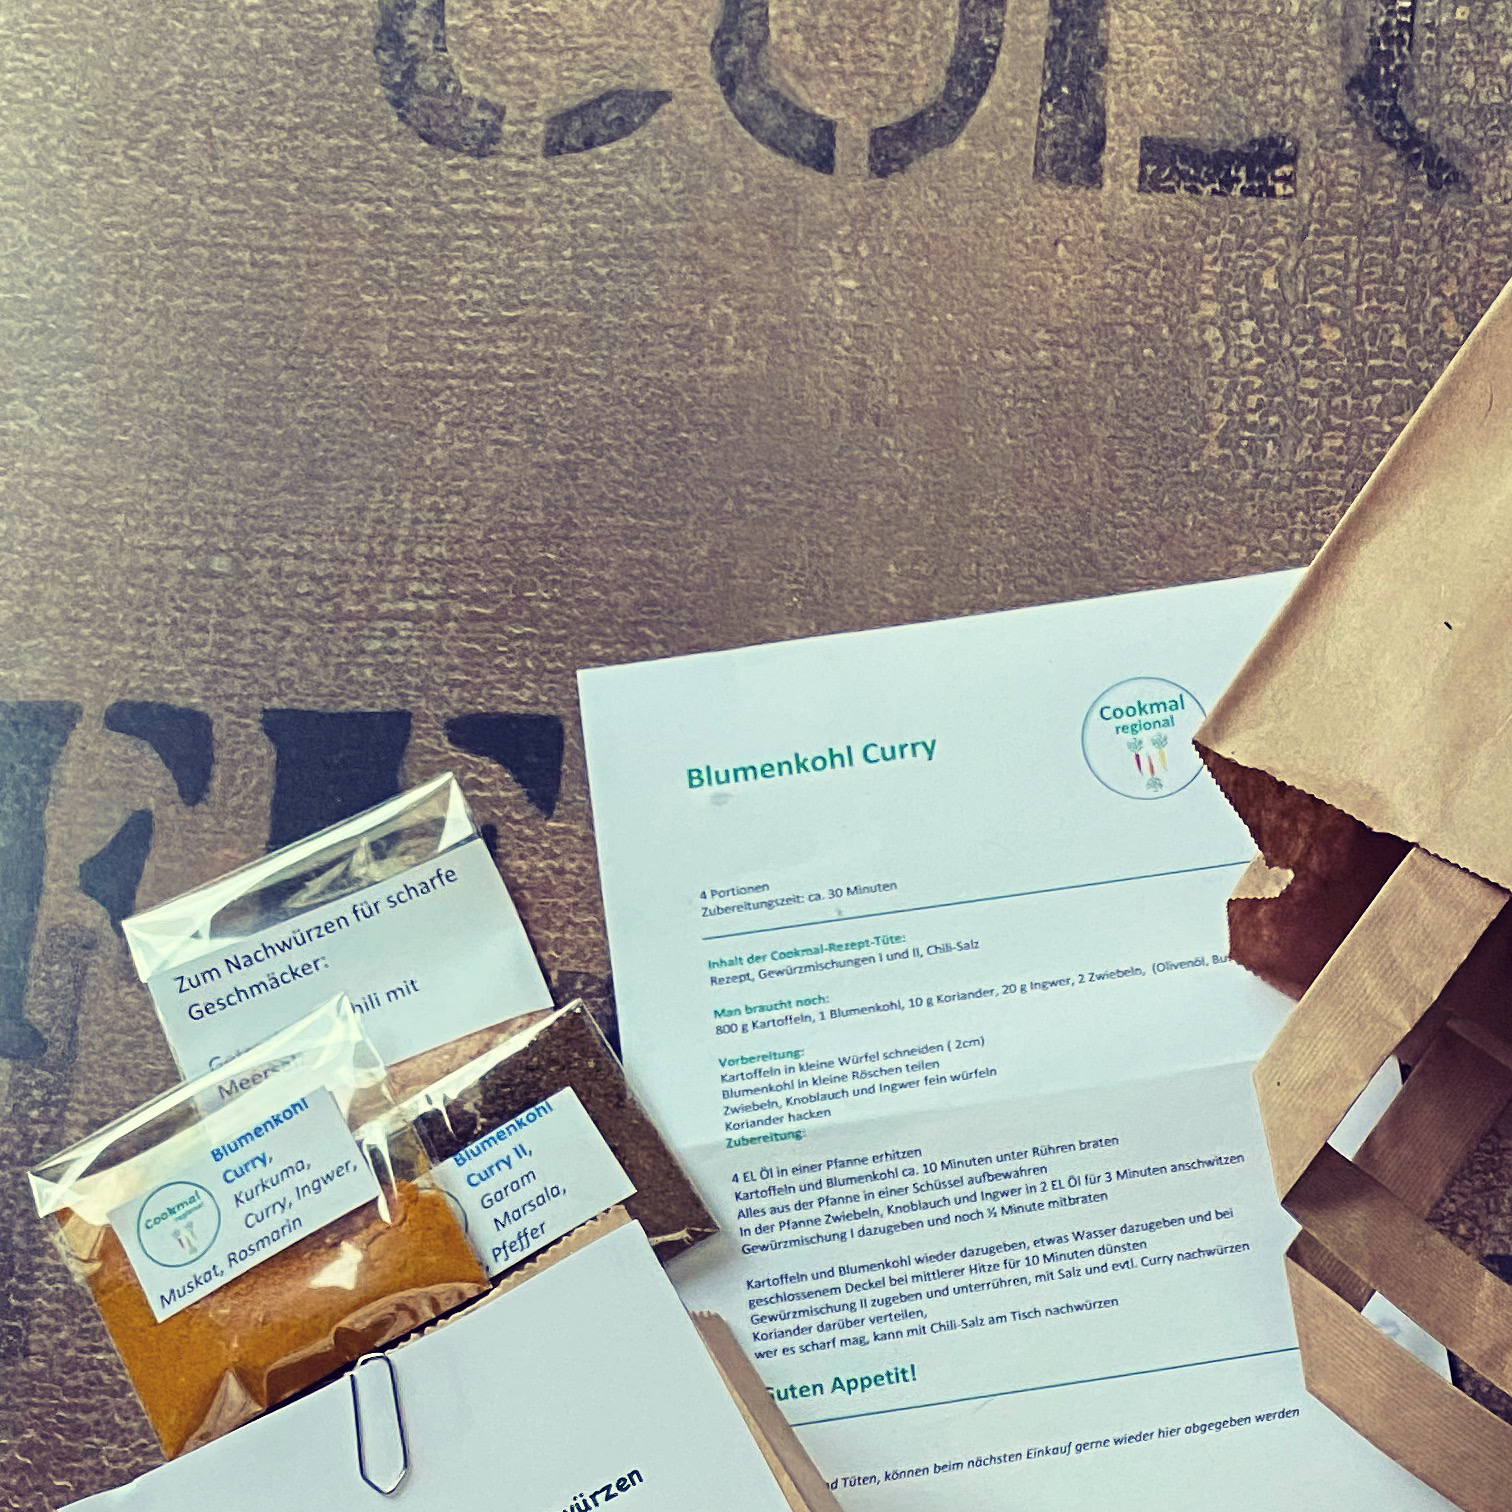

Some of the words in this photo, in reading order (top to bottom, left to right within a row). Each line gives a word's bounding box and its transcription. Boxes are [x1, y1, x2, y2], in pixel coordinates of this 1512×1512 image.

[1099, 693, 1185, 722] Cookmal
[1113, 709, 1176, 736] regional
[685, 743, 854, 790] Blumenkohl
[861, 738, 937, 765] Curry
[698, 889, 708, 901] 4
[709, 882, 771, 899] Portionen
[699, 893, 806, 918] Zubereitungszeit:
[806, 891, 825, 903] ca.
[827, 886, 844, 900] 30
[845, 881, 898, 897] Minuten
[172, 966, 223, 995] Zum
[222, 914, 351, 975] Nachwürzen
[351, 899, 381, 923] für
[385, 866, 458, 909] scharfe
[706, 954, 745, 971] Inhalt
[745, 952, 768, 965] der
[769, 933, 907, 962] Cookmal-Rezept-Tüte:
[708, 971, 756, 987] Rezept,
[756, 954, 877, 981] Gewürzmischungen
[884, 947, 910, 962] und
[925, 938, 981, 956] Chili-Salz
[187, 955, 330, 1021] Geschmäcker:
[712, 1006, 743, 1020] Man
[743, 998, 793, 1016] braucht
[794, 993, 830, 1008] noch:
[716, 1048, 805, 1069] Vorbereitung:
[209, 1096, 310, 1163] Blumenkohl
[723, 1114, 785, 1132] Koriander
[786, 1107, 832, 1123] hacken
[724, 1128, 807, 1150] Zubereitung:
[221, 1150, 274, 1185] Curry,
[232, 1158, 312, 1209] Kurkuma,
[465, 1153, 513, 1188] Curry
[730, 1172, 740, 1184] 4
[741, 1169, 758, 1184] EL
[758, 1165, 774, 1181] Öl
[774, 1165, 789, 1178] in
[790, 1162, 823, 1177] einer
[825, 1155, 870, 1171] Pfanne
[870, 1147, 923, 1164] erhitzen
[733, 1182, 797, 1203] Kartoffeln
[797, 1177, 824, 1193] und
[824, 1166, 900, 1189] Blumenkohl
[900, 1166, 920, 1178] ca.
[921, 1160, 939, 1175] 10
[939, 1155, 994, 1172] Minuten
[994, 1149, 1029, 1164] unter
[1030, 1142, 1077, 1158] Rühren
[1077, 1136, 1120, 1152] braten
[145, 1190, 200, 1230] Cookmal
[243, 1195, 294, 1230] Curry,
[293, 1159, 358, 1201] Ingwer,
[479, 1169, 537, 1210] Garam
[492, 1184, 567, 1233] Marsala,
[736, 1205, 768, 1221] Alles
[768, 1203, 792, 1216] aus
[792, 1198, 815, 1212] der
[816, 1193, 861, 1209] Pfanne
[861, 1189, 876, 1202] in
[876, 1185, 910, 1200] einer
[911, 1174, 965, 1195] Schüssel
[966, 1164, 1049, 1186] aufbewahren
[492, 1220, 546, 1262] Pfeffer
[159, 1264, 224, 1309] Muskat,
[227, 1217, 303, 1268] Rosmarin
[749, 1300, 858, 1326] Gewürzmischung
[869, 1291, 924, 1309] zugeben
[924, 1284, 950, 1300] und
[951, 1275, 1032, 1296] unterrühren,
[1033, 1269, 1056, 1284] mit
[1056, 1265, 1083, 1281] Salz
[1083, 1261, 1109, 1276] und
[1110, 1256, 1138, 1272] evtl.
[1139, 1253, 1175, 1268] Curry
[1175, 1242, 1251, 1262] nachwürzen
[750, 1323, 814, 1343] Koriander
[815, 1316, 866, 1334] darüber
[867, 1307, 928, 1326] verteilen,
[753, 1347, 779, 1360] wer
[780, 1345, 797, 1357] es
[797, 1335, 837, 1354] scharf
[838, 1334, 871, 1348] mag,
[871, 1329, 904, 1343] kann
[905, 1323, 928, 1338] mit
[929, 1314, 986, 1335] Chili-Salz
[987, 1313, 1008, 1326] am
[1008, 1306, 1042, 1322] Tisch
[1043, 1297, 1120, 1318] nachwürzen
[829, 1362, 917, 1396] Appetit!
[840, 1473, 881, 1488] Tüten,
[883, 1465, 930, 1482] können
[932, 1459, 965, 1475] beim
[966, 1451, 1023, 1470] nächsten
[1025, 1440, 1073, 1460] Einkauf
[1073, 1437, 1111, 1455] gerne
[1112, 1429, 1155, 1447] wieder
[1156, 1425, 1182, 1439] hier
[1183, 1415, 1252, 1436] abgegeben
[1253, 1406, 1301, 1423] werden
